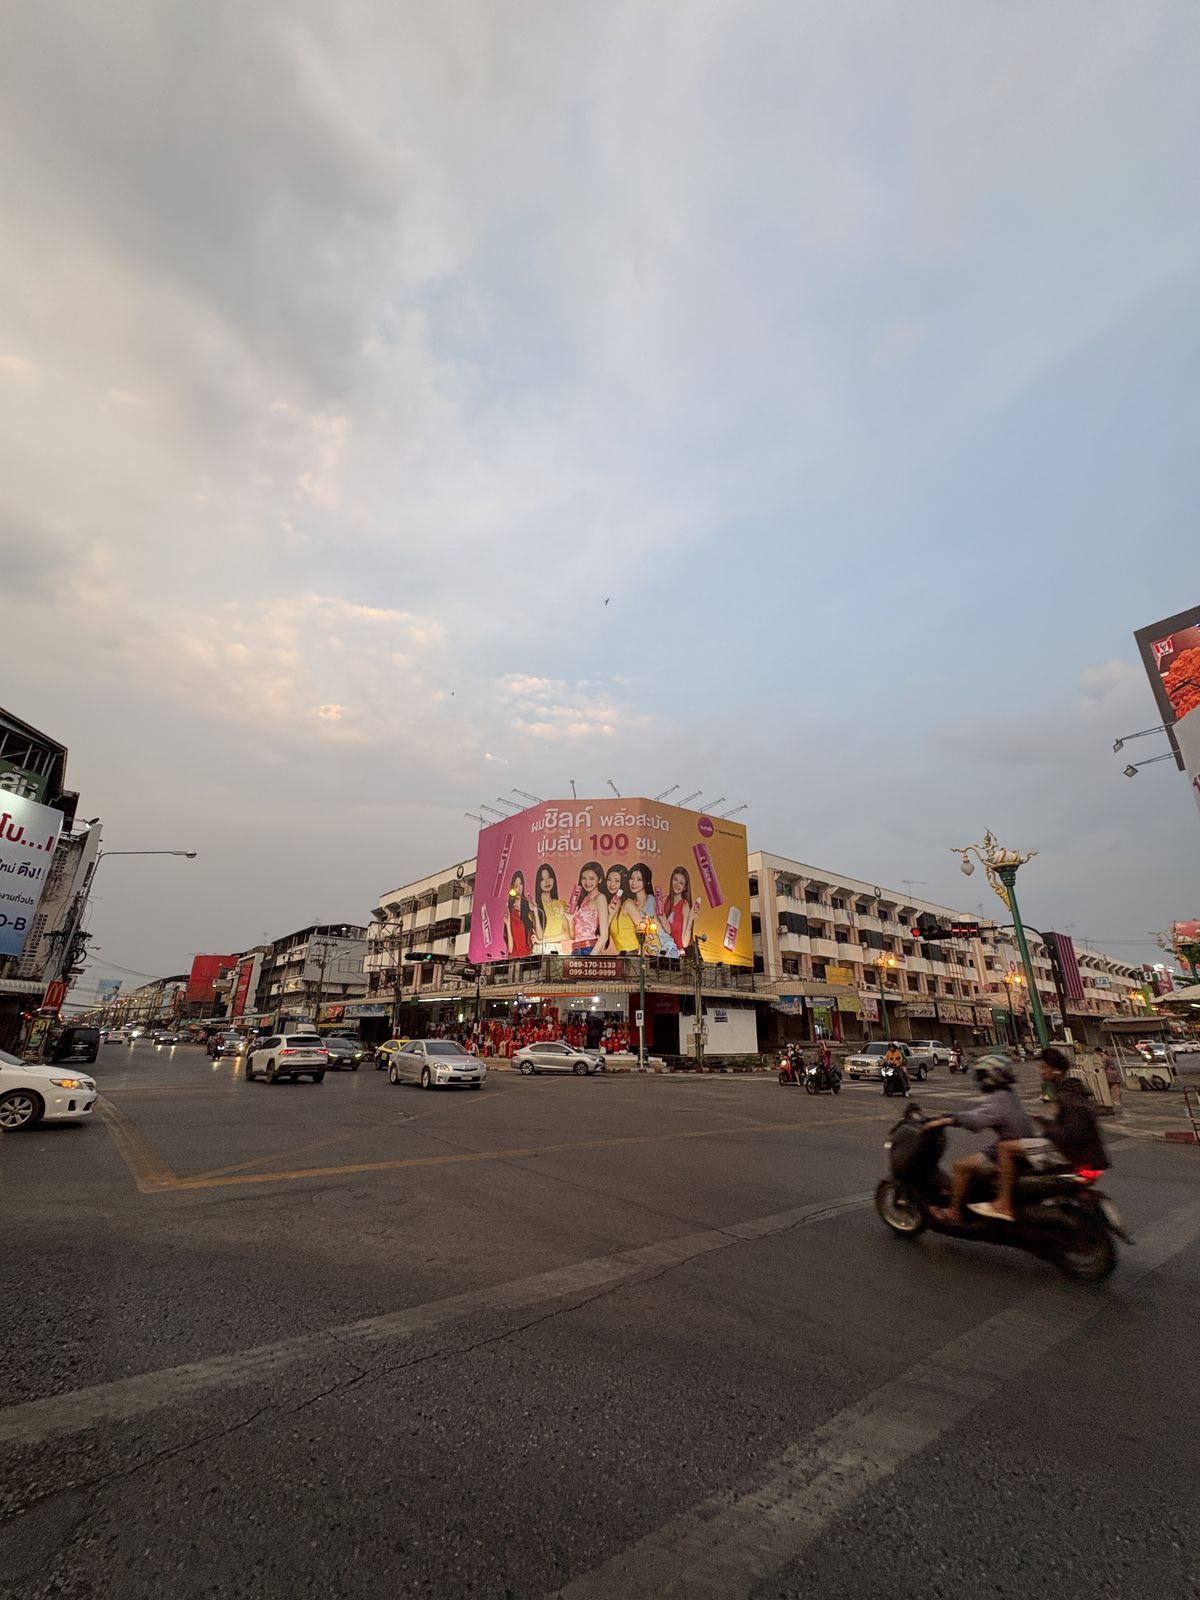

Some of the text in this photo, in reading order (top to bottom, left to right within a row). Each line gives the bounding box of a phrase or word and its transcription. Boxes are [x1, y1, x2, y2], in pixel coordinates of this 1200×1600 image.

[600, 807, 670, 832] พลิ้วสะบัด
[537, 830, 662, 857] นุ่มลื่น 100 ชม.
[0, 859, 17, 873] หม่
[1143, 971, 1161, 982] ยา
